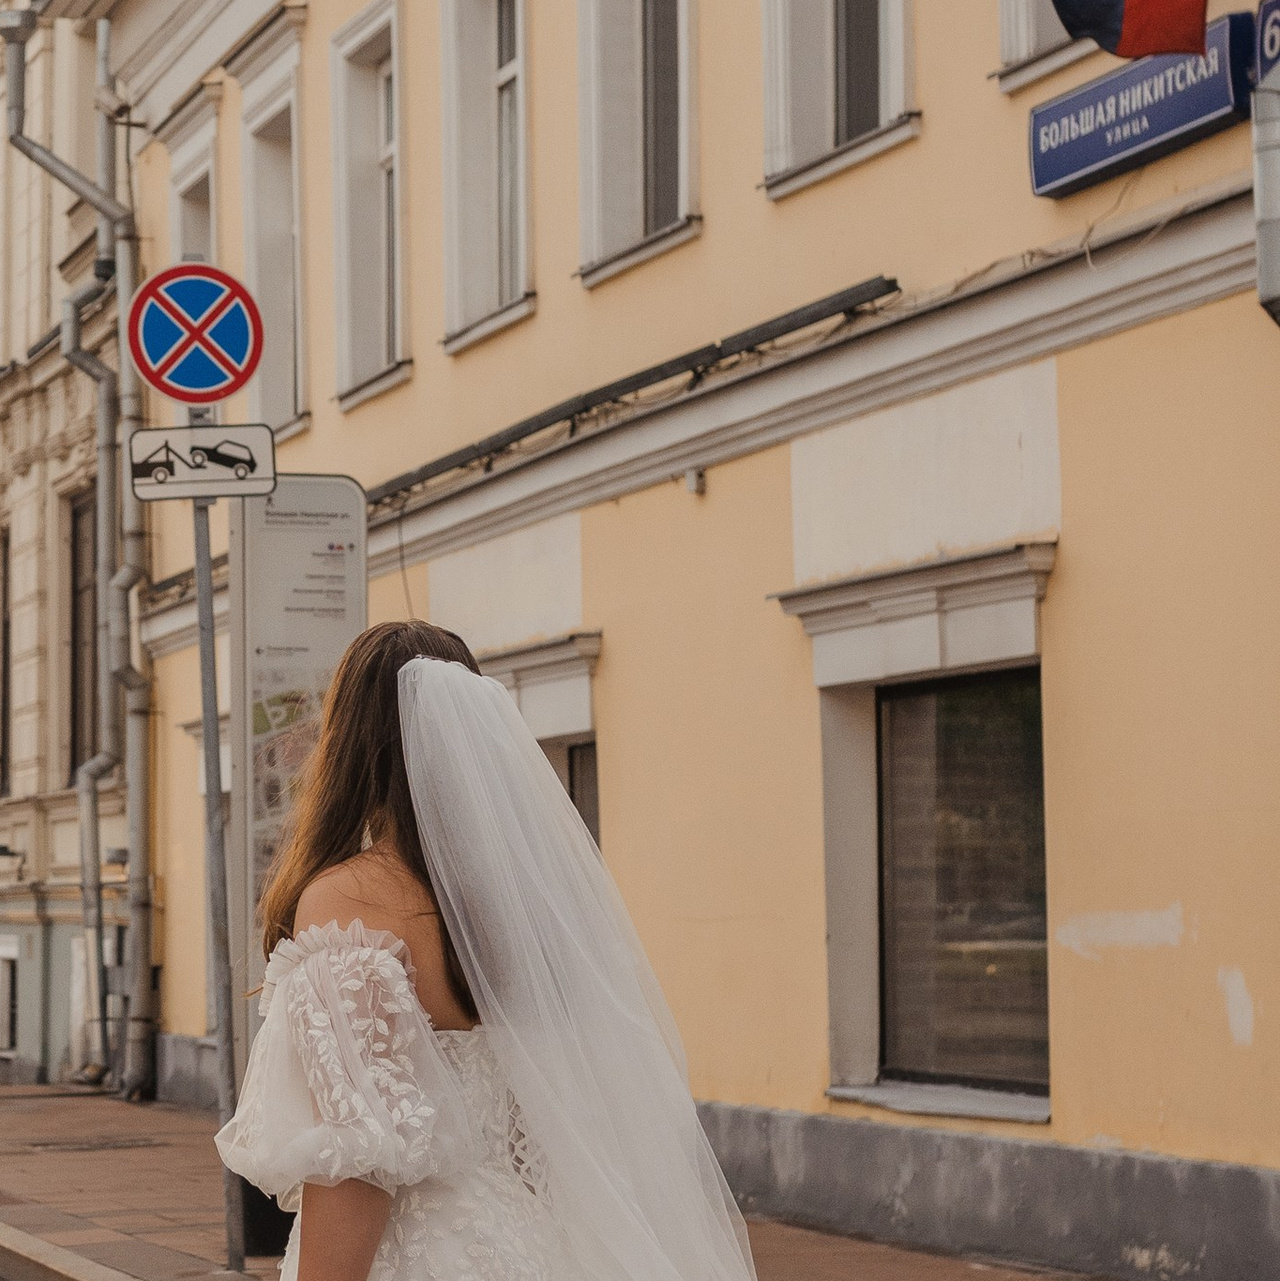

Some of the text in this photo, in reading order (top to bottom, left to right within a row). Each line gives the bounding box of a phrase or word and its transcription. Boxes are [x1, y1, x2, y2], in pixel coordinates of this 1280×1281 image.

[1039, 46, 1219, 154] БОЛЬШАЯ НИКИТСКАЯ
[1105, 115, 1150, 147] УЛИЦА
